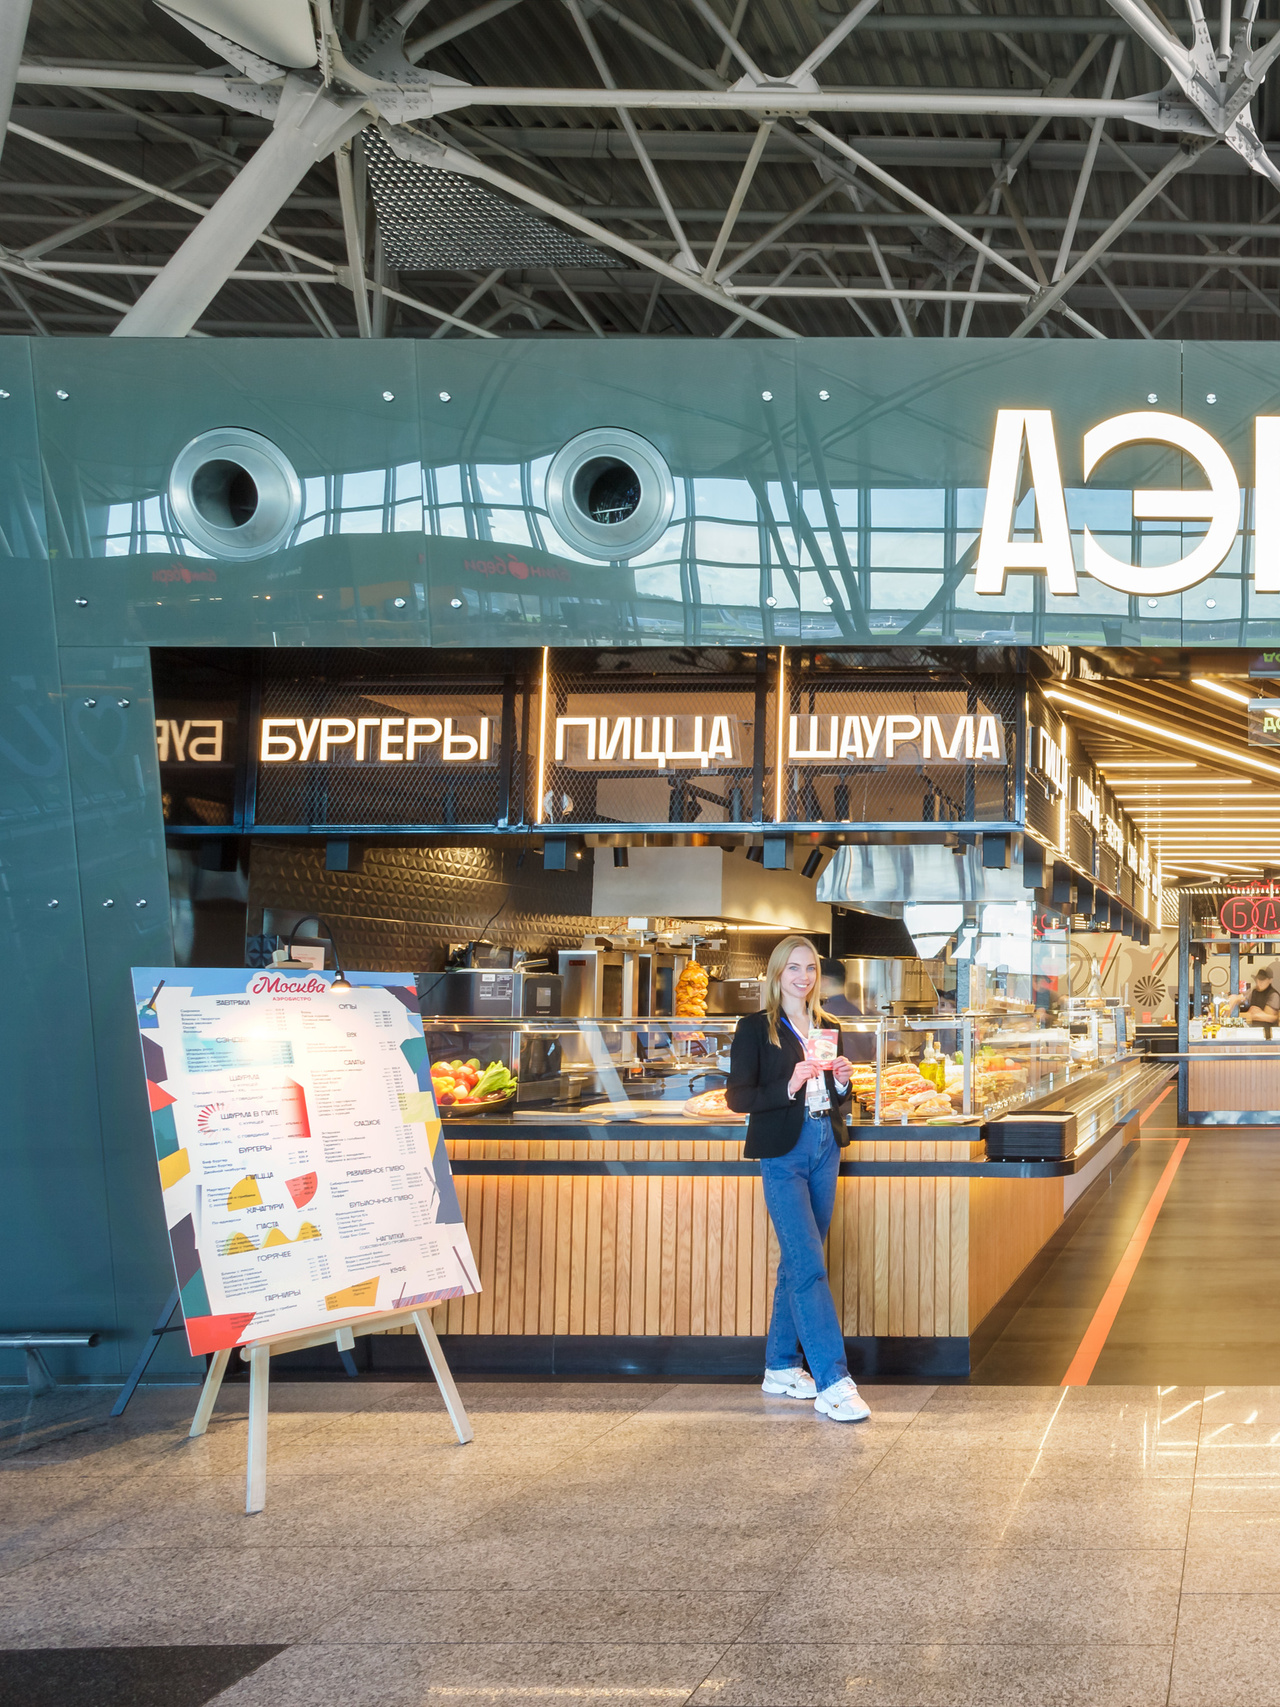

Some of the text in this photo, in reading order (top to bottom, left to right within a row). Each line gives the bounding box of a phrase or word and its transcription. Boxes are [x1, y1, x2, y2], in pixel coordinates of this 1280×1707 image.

[260, 717, 489, 762] БУРГЕРЫ
[556, 716, 733, 768] ПИЦЦА
[788, 714, 1001, 759] ШАУРМА
[252, 976, 326, 995] Москва
[220, 1109, 279, 1120] ШАУРМА В ПИТЕ
[238, 1144, 273, 1154] БУРГЕРЫ
[245, 1172, 274, 1181] ПИЦЦА
[346, 1164, 406, 1177] РАЗЛИВНОЕ ПИВО
[349, 1193, 414, 1208] БУТЫЛОЧНОЕ ПИВО
[246, 1203, 285, 1214] ХАЧАПУРИ
[256, 1221, 280, 1230] ПАСТА
[375, 1232, 405, 1243] НАПИТКИ
[257, 1250, 292, 1262] ГОРЯЧЕЕ
[264, 1289, 301, 1302] ГАРНИРЫ
